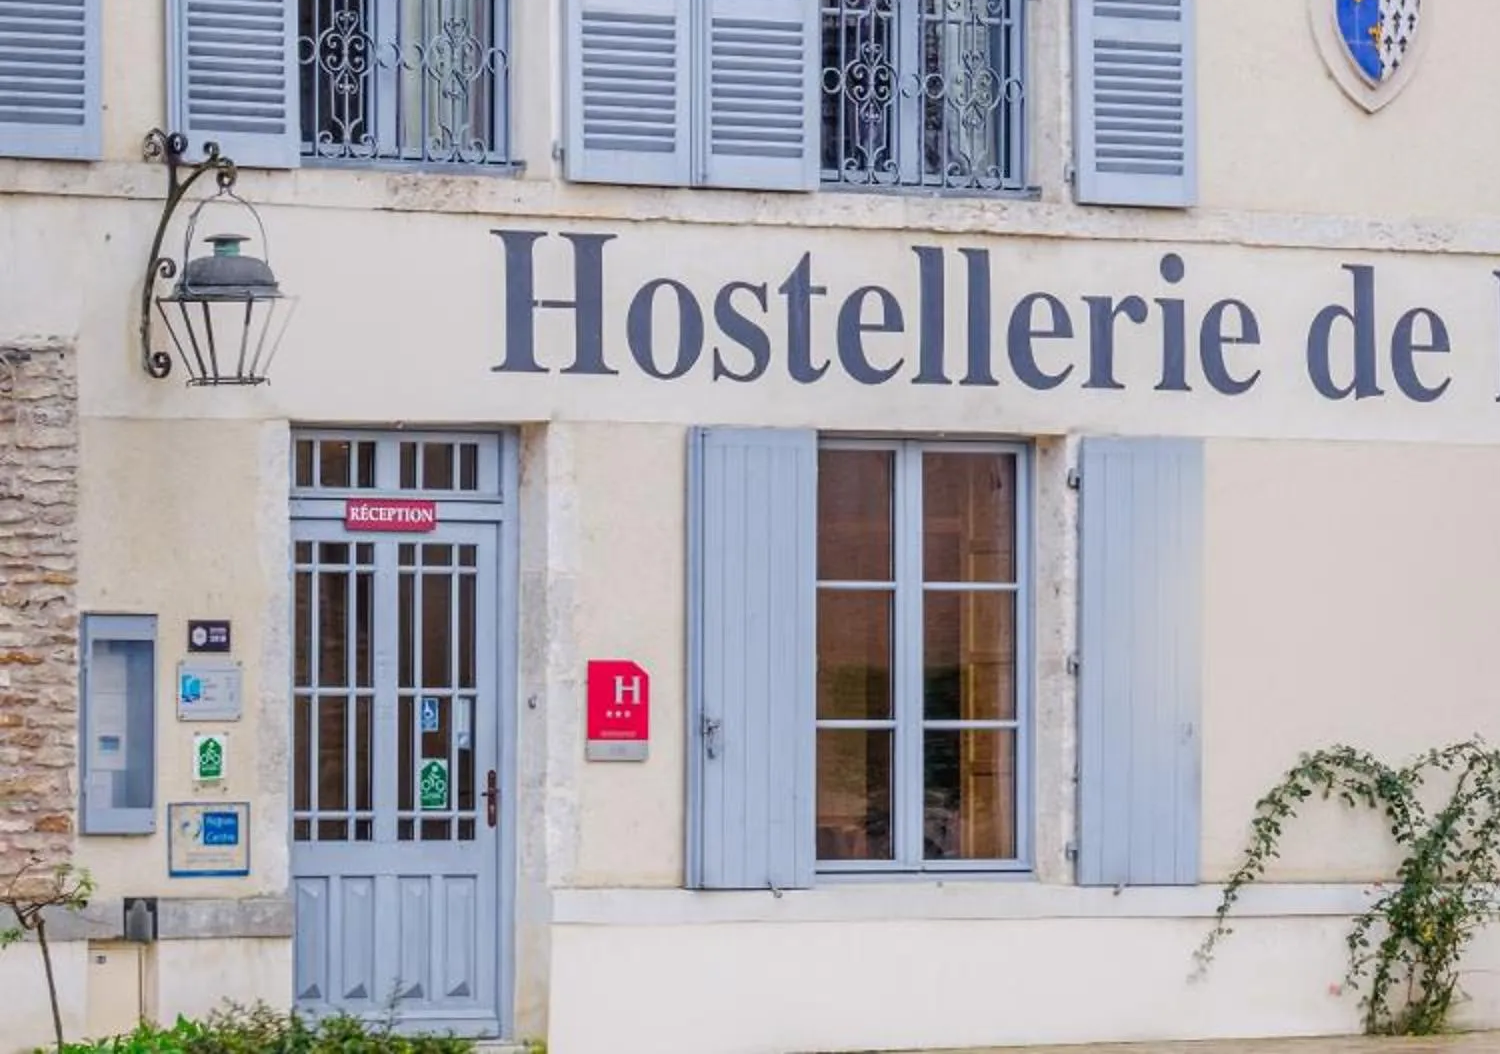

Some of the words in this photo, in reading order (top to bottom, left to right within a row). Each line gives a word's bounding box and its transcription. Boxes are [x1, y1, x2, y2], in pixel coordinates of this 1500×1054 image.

[490, 230, 1261, 396] Hostellerie
[1307, 263, 1452, 403] de
[350, 503, 434, 523] RÉCEPTION
[614, 675, 641, 705] H
